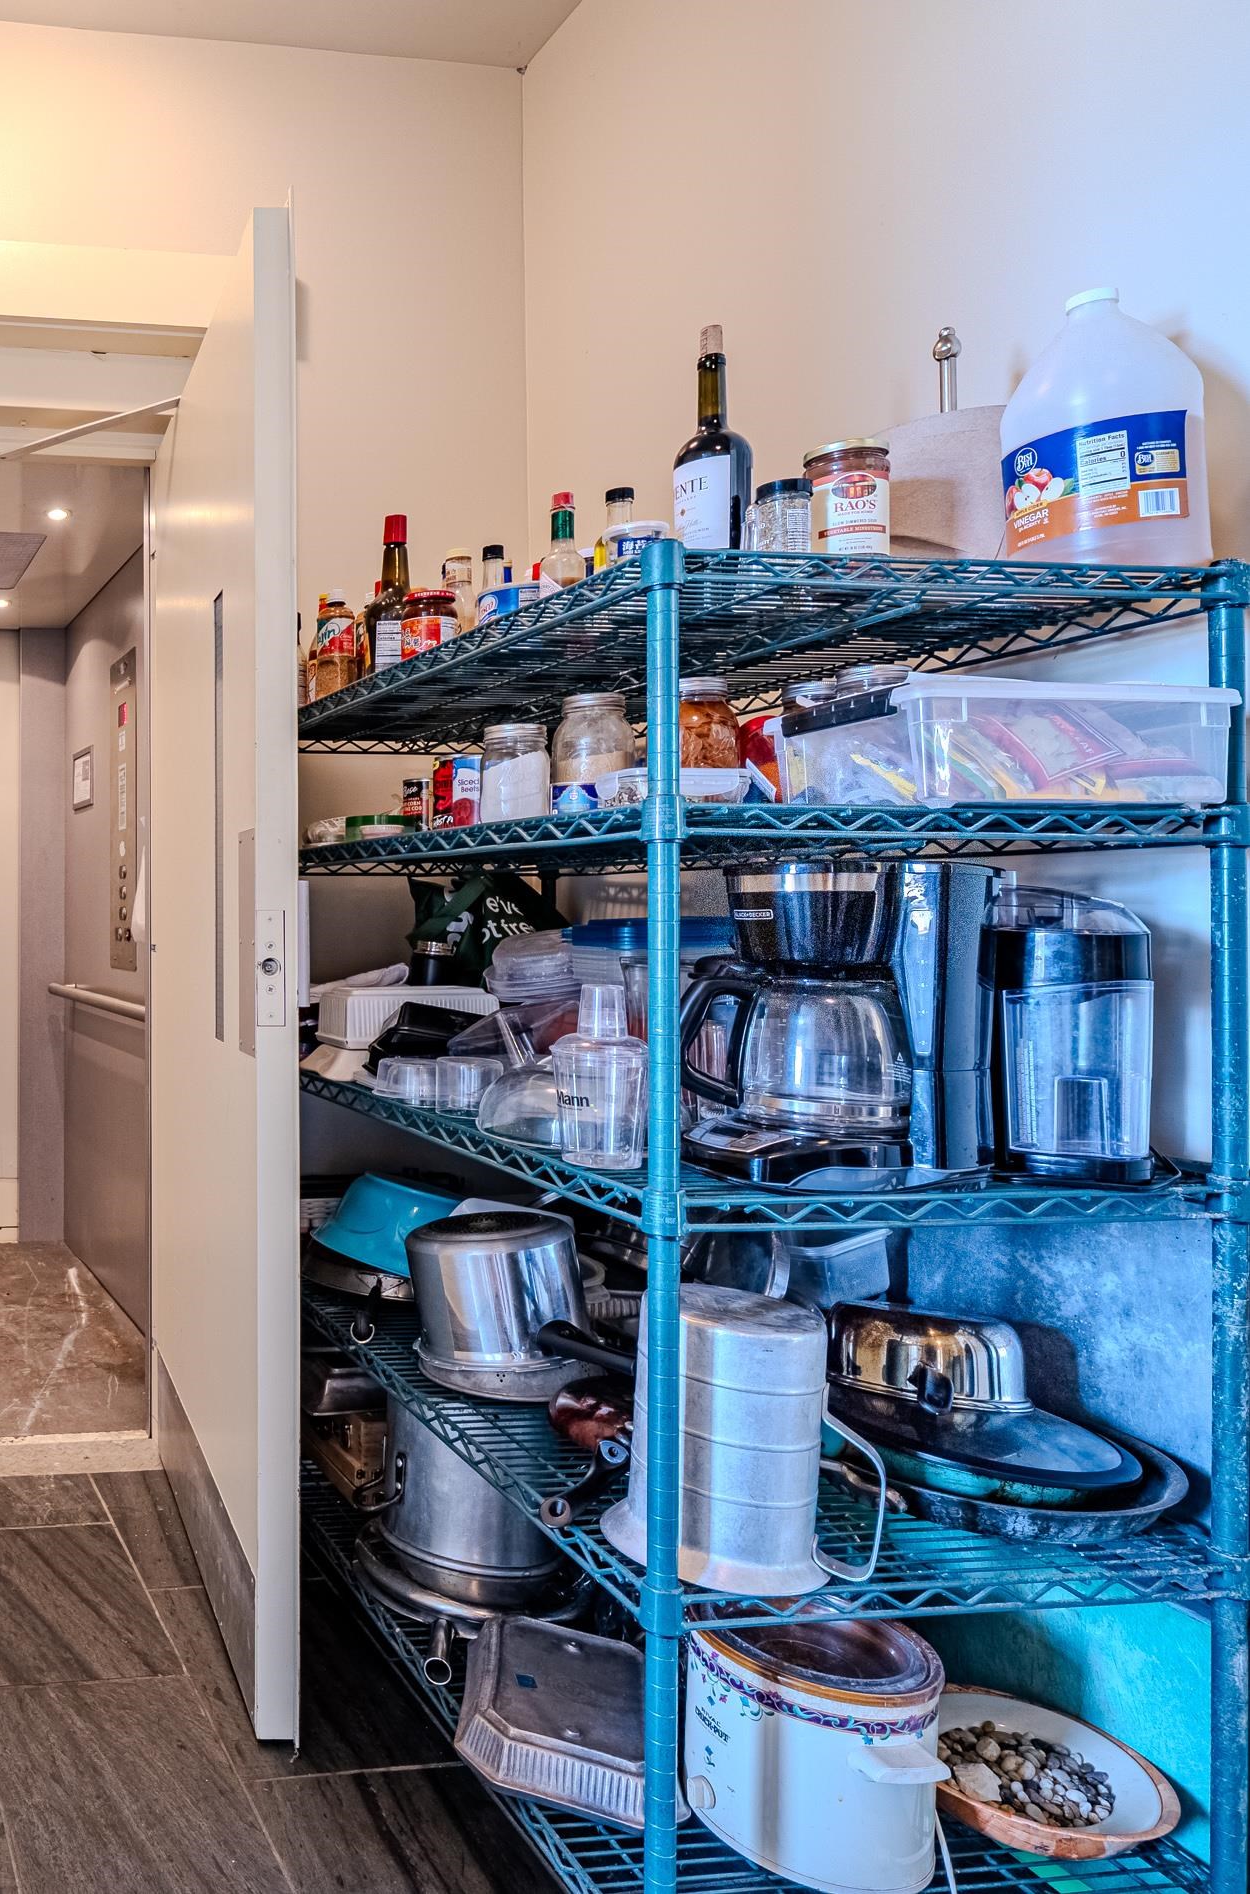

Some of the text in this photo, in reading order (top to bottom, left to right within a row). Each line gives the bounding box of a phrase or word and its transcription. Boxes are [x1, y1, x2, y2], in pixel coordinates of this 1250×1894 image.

[1078, 433, 1125, 447] Nutrition Facts
[1079, 450, 1126, 466] Calories 0
[675, 475, 709, 500] ENTE
[834, 499, 876, 513] RAO'S
[1014, 508, 1049, 529] VINEGAR
[482, 896, 524, 916] e'v
[694, 1705, 731, 1743] CROCK-POT
